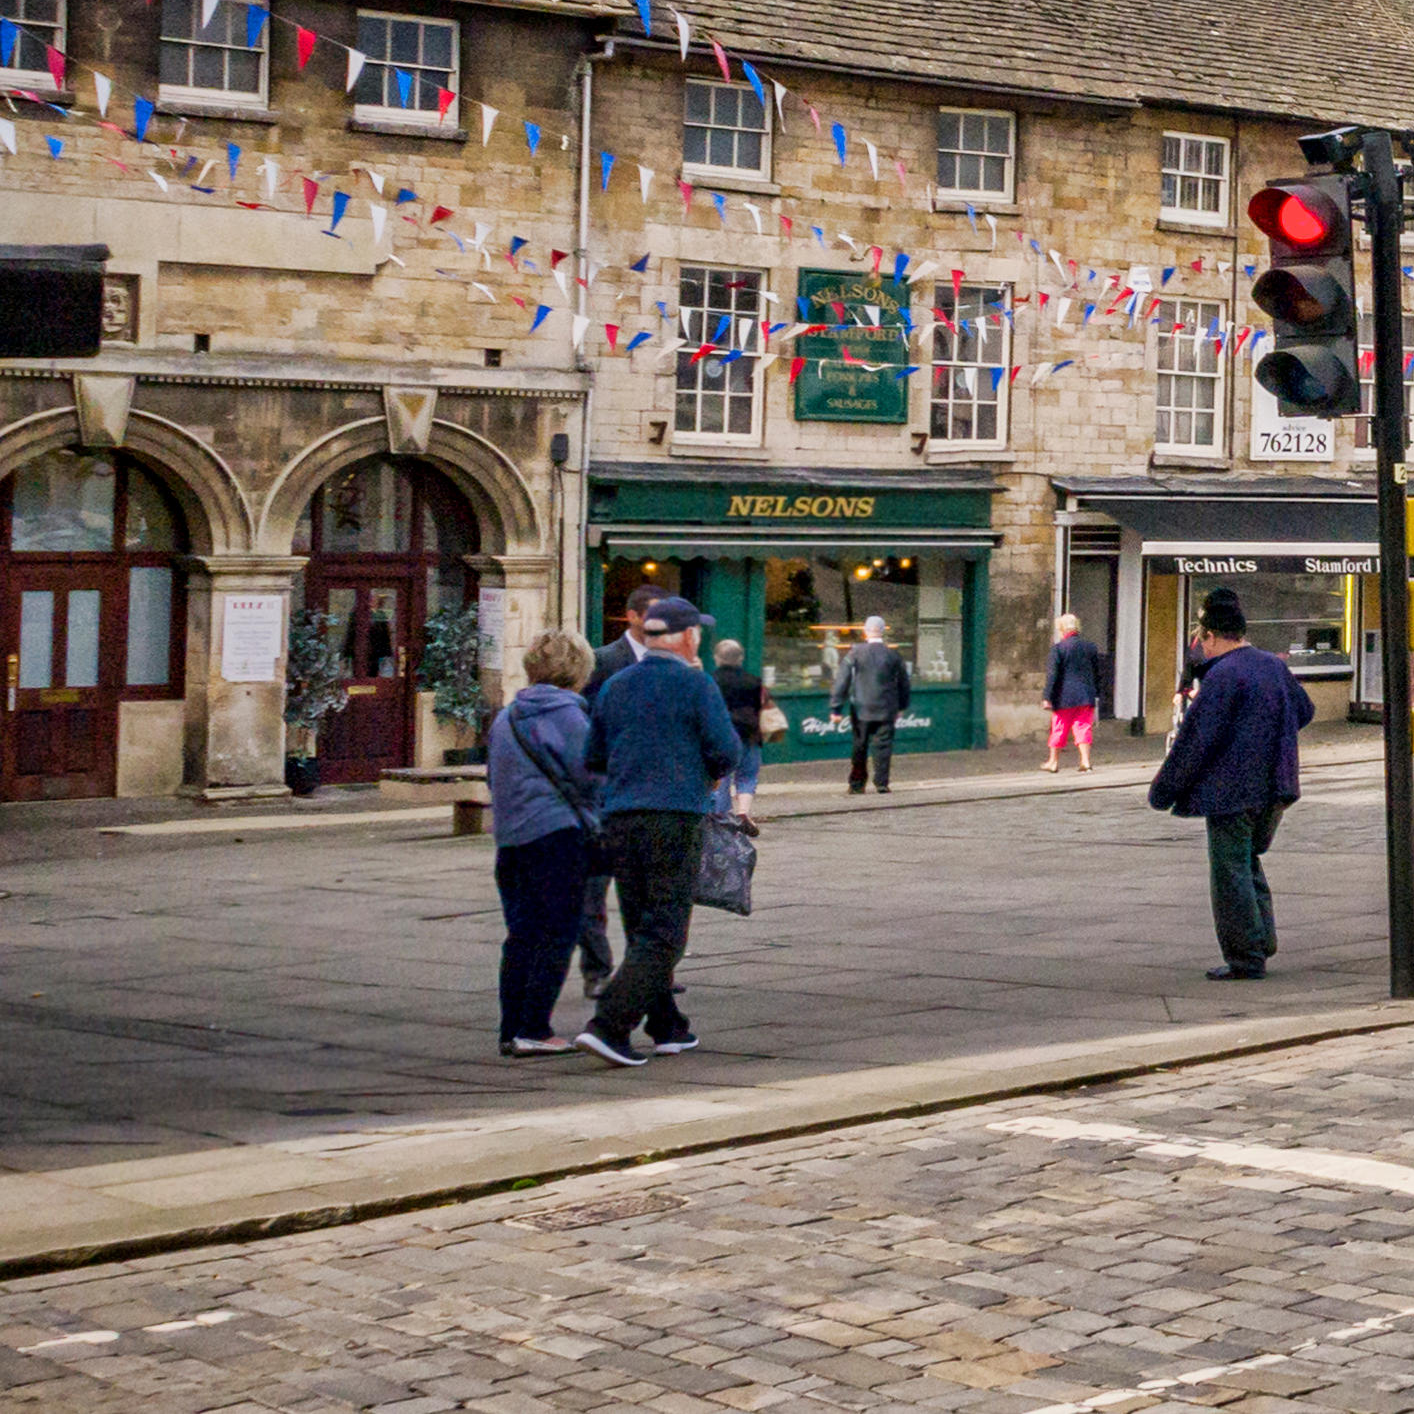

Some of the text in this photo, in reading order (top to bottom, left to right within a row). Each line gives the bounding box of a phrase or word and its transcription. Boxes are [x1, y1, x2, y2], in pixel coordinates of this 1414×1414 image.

[810, 284, 899, 315] NELSONS
[1260, 433, 1327, 453] 762128
[727, 495, 875, 518] NELSONS
[1174, 557, 1258, 574] Technics
[1305, 558, 1372, 574] Stamford
[802, 717, 835, 736] High
[894, 714, 931, 729] tchers
